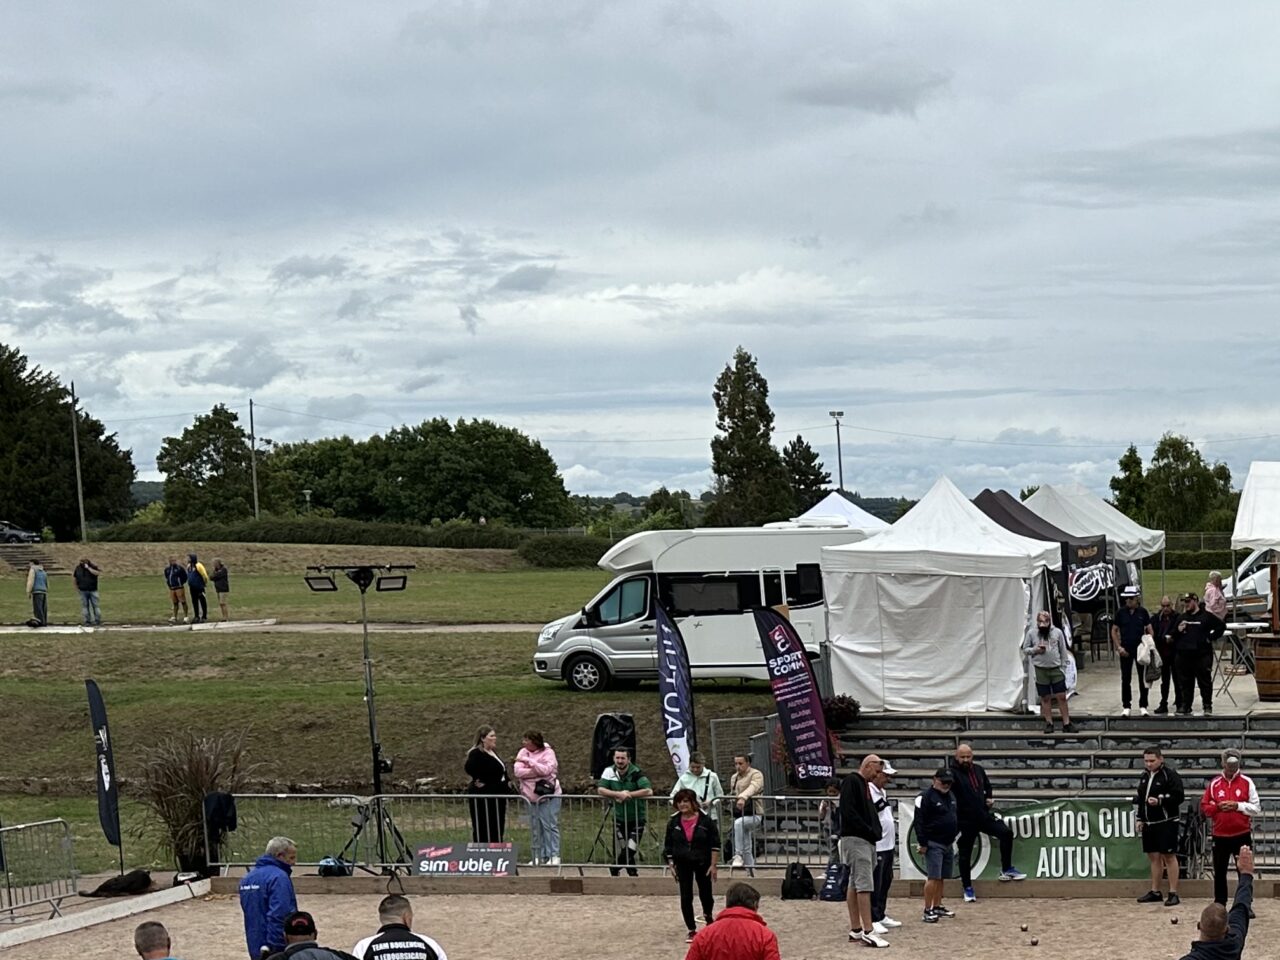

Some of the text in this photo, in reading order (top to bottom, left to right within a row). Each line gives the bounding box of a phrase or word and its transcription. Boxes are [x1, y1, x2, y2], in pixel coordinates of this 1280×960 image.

[768, 650, 803, 668] SPORT
[773, 662, 805, 676] COMM
[1098, 806, 1143, 839] Clu
[419, 857, 510, 873] simeuble.fr
[1036, 846, 1107, 878] AUTUN
[372, 941, 390, 952] TEAM
